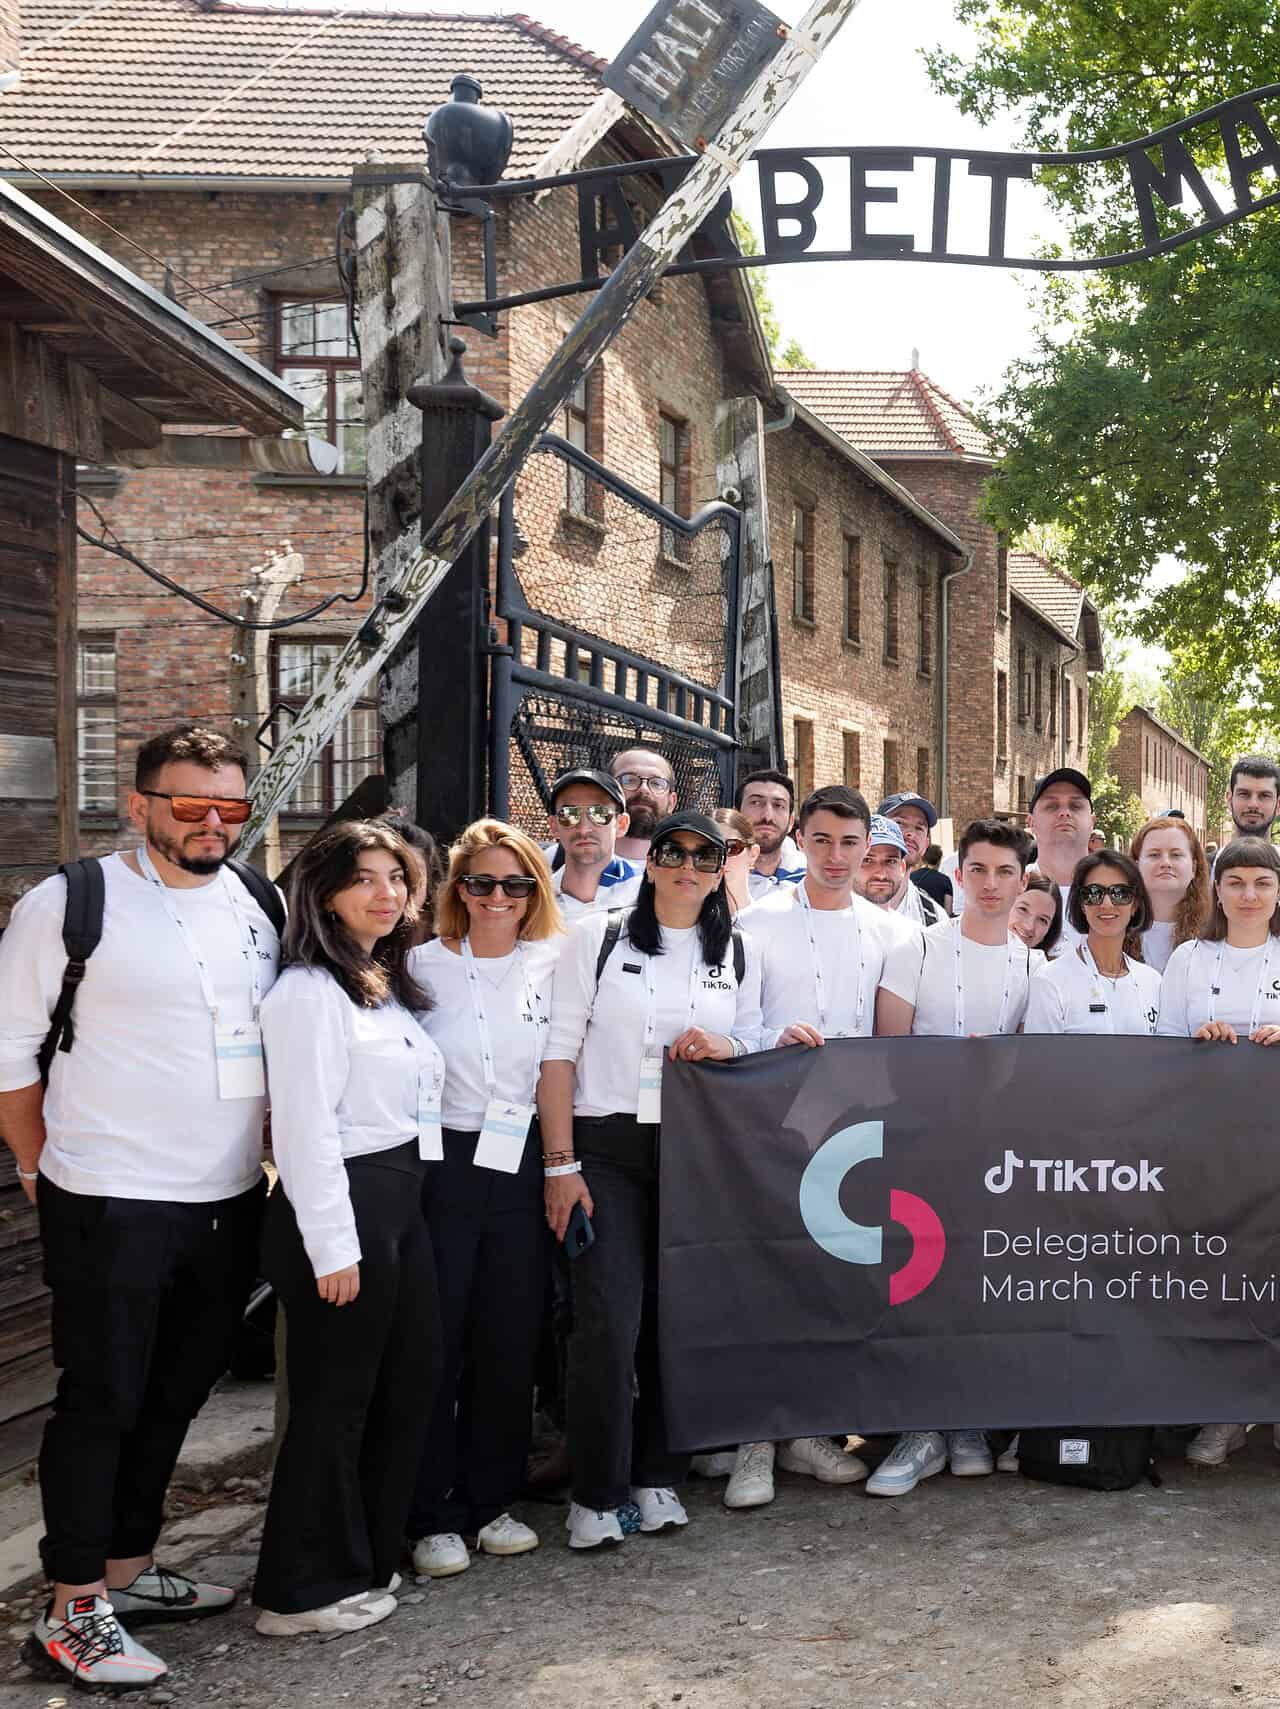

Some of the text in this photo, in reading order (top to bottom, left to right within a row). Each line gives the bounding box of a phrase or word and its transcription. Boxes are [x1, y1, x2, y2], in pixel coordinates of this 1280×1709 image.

[626, 0, 723, 99] HALT
[242, 950, 272, 960] TTok
[1029, 1159, 1166, 1193] TikTok
[982, 1227, 1228, 1261] Delegation to
[982, 1271, 1094, 1302] March
[1105, 1271, 1141, 1300] of
[1149, 1272, 1209, 1301] the
